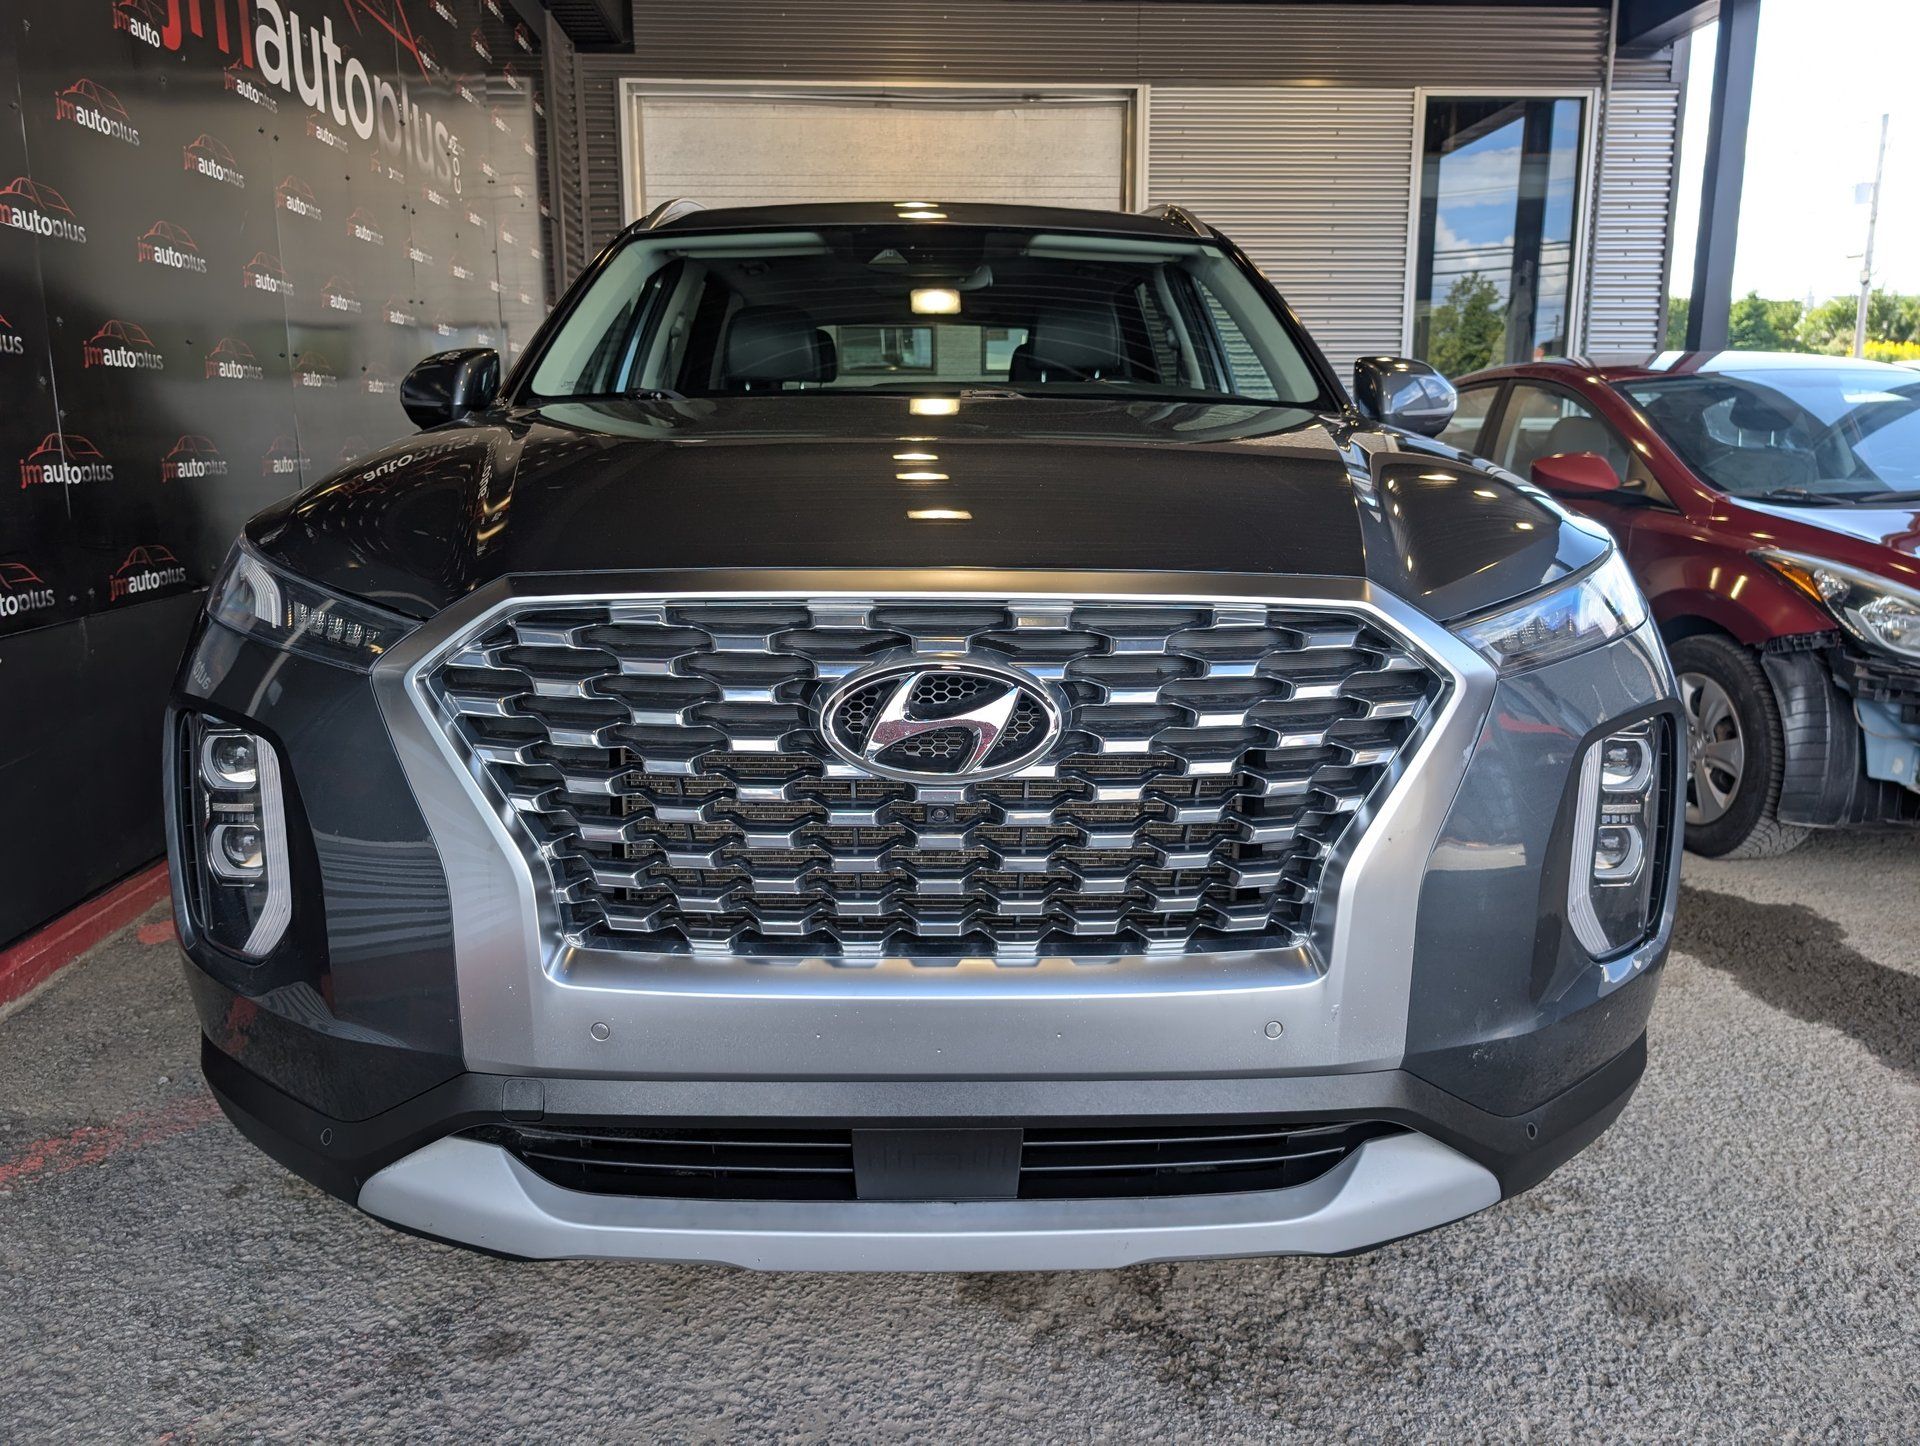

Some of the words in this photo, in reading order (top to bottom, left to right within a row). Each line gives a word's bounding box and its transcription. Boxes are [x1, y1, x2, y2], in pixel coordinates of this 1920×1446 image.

[55, 91, 140, 145] jmautoplus
[184, 145, 245, 189] jmautoplus
[137, 236, 206, 273] jmautoplus
[83, 340, 164, 370] jmautoplus
[20, 458, 114, 489] jmautoplus
[161, 458, 228, 483] jmautoplus
[109, 566, 186, 602] jmautoplus
